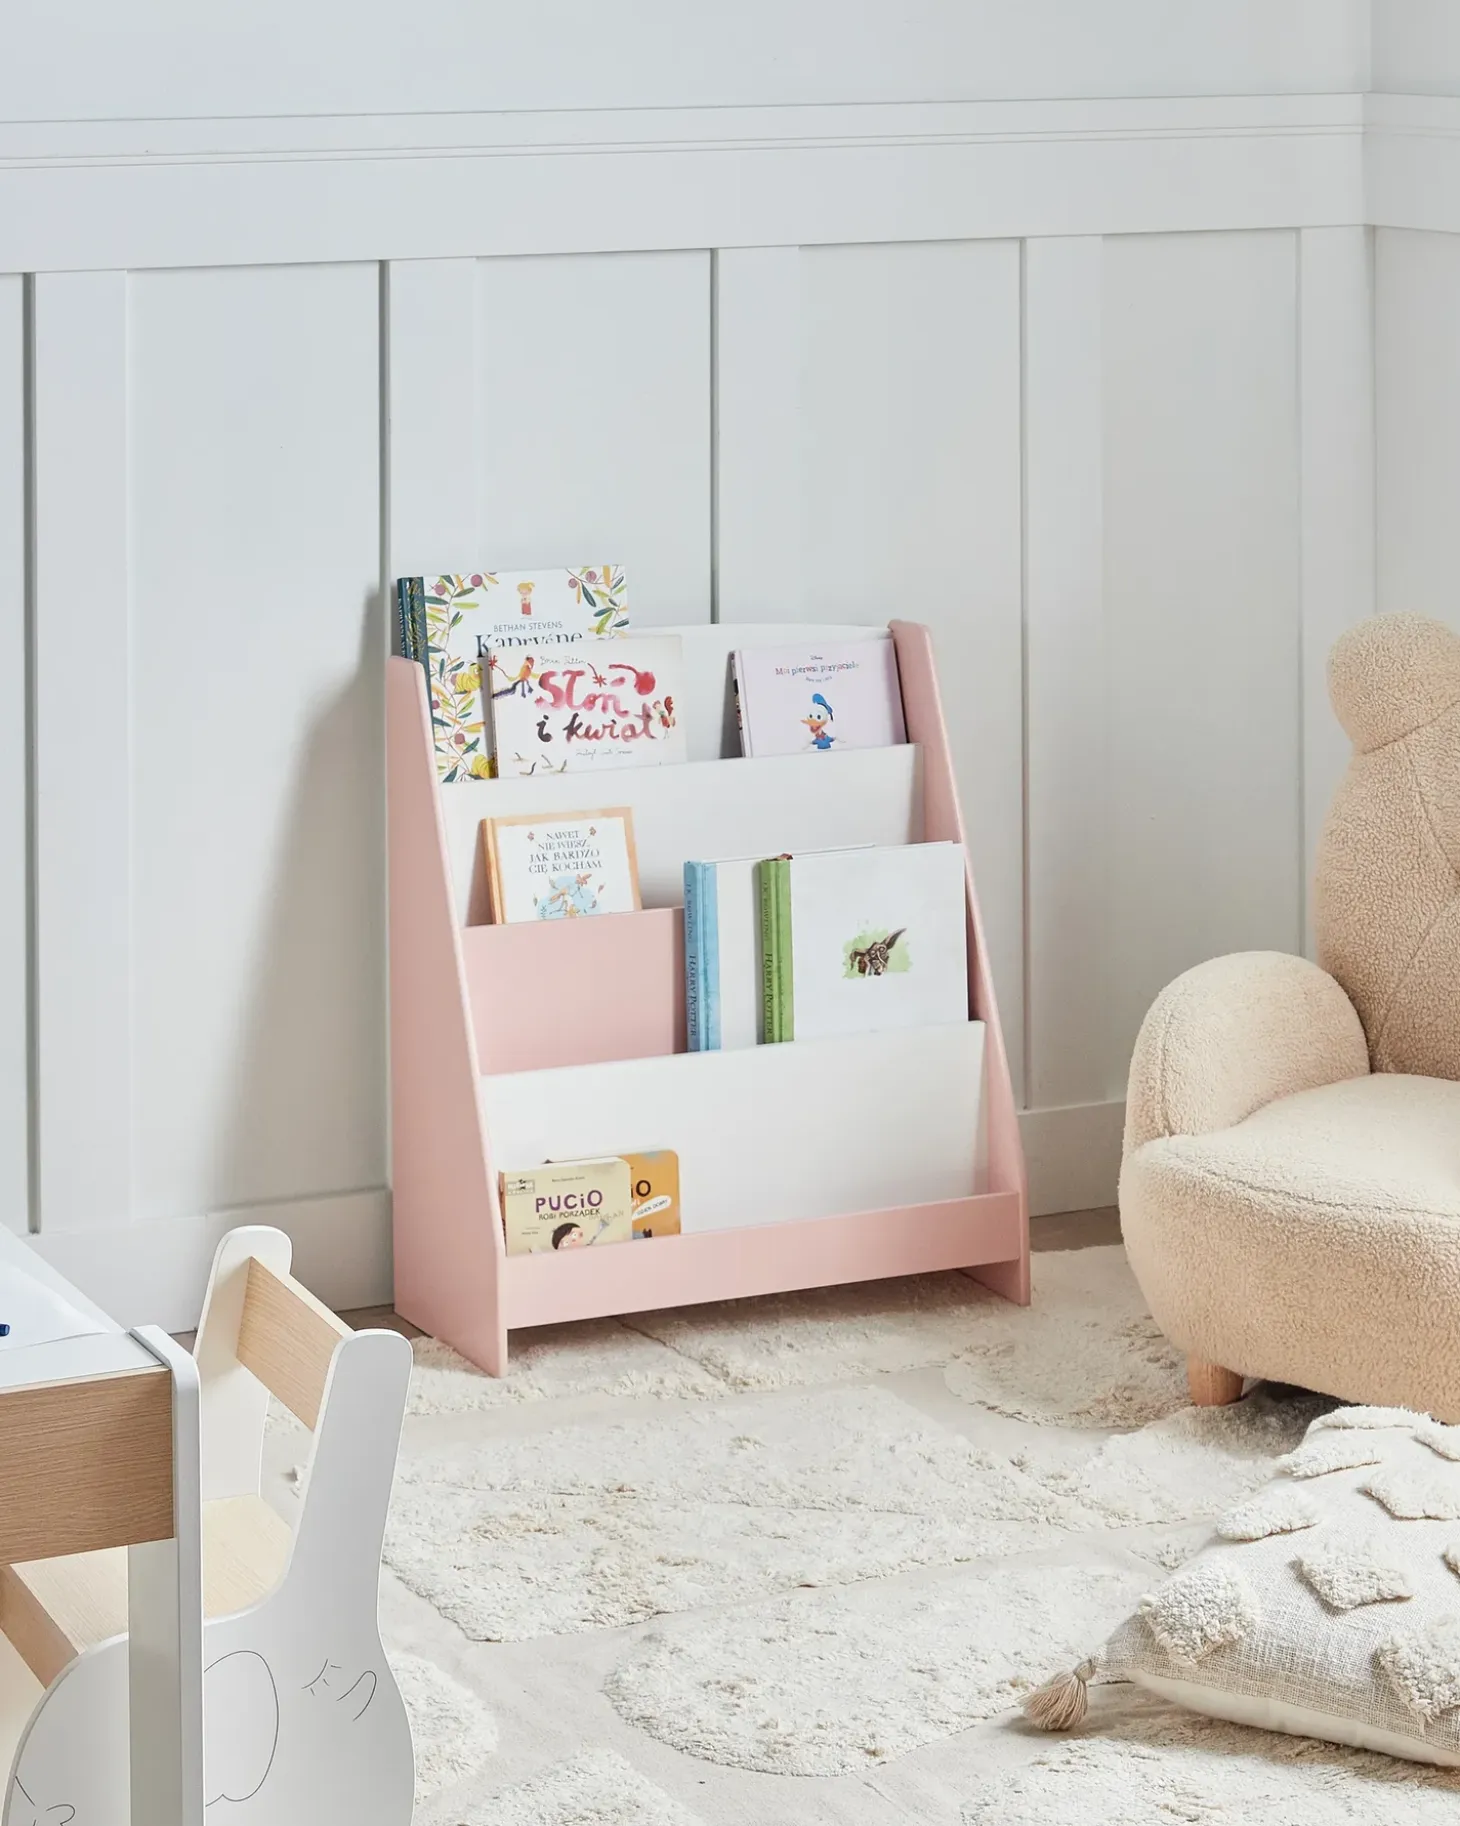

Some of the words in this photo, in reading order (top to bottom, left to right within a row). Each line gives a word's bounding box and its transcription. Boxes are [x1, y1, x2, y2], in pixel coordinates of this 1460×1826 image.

[493, 623, 526, 633] BETHAN
[528, 620, 563, 631] STEVENS
[536, 714, 553, 742] i
[563, 702, 657, 743] kwiat
[547, 830, 579, 840] NAWET
[538, 842, 556, 851] NIE
[529, 852, 549, 863] JAK
[553, 849, 600, 861] BARDZO
[552, 860, 603, 872] KOCHAM
[689, 955, 697, 993] HARRY
[764, 953, 773, 991] HARRY
[766, 993, 774, 1035] POTTER
